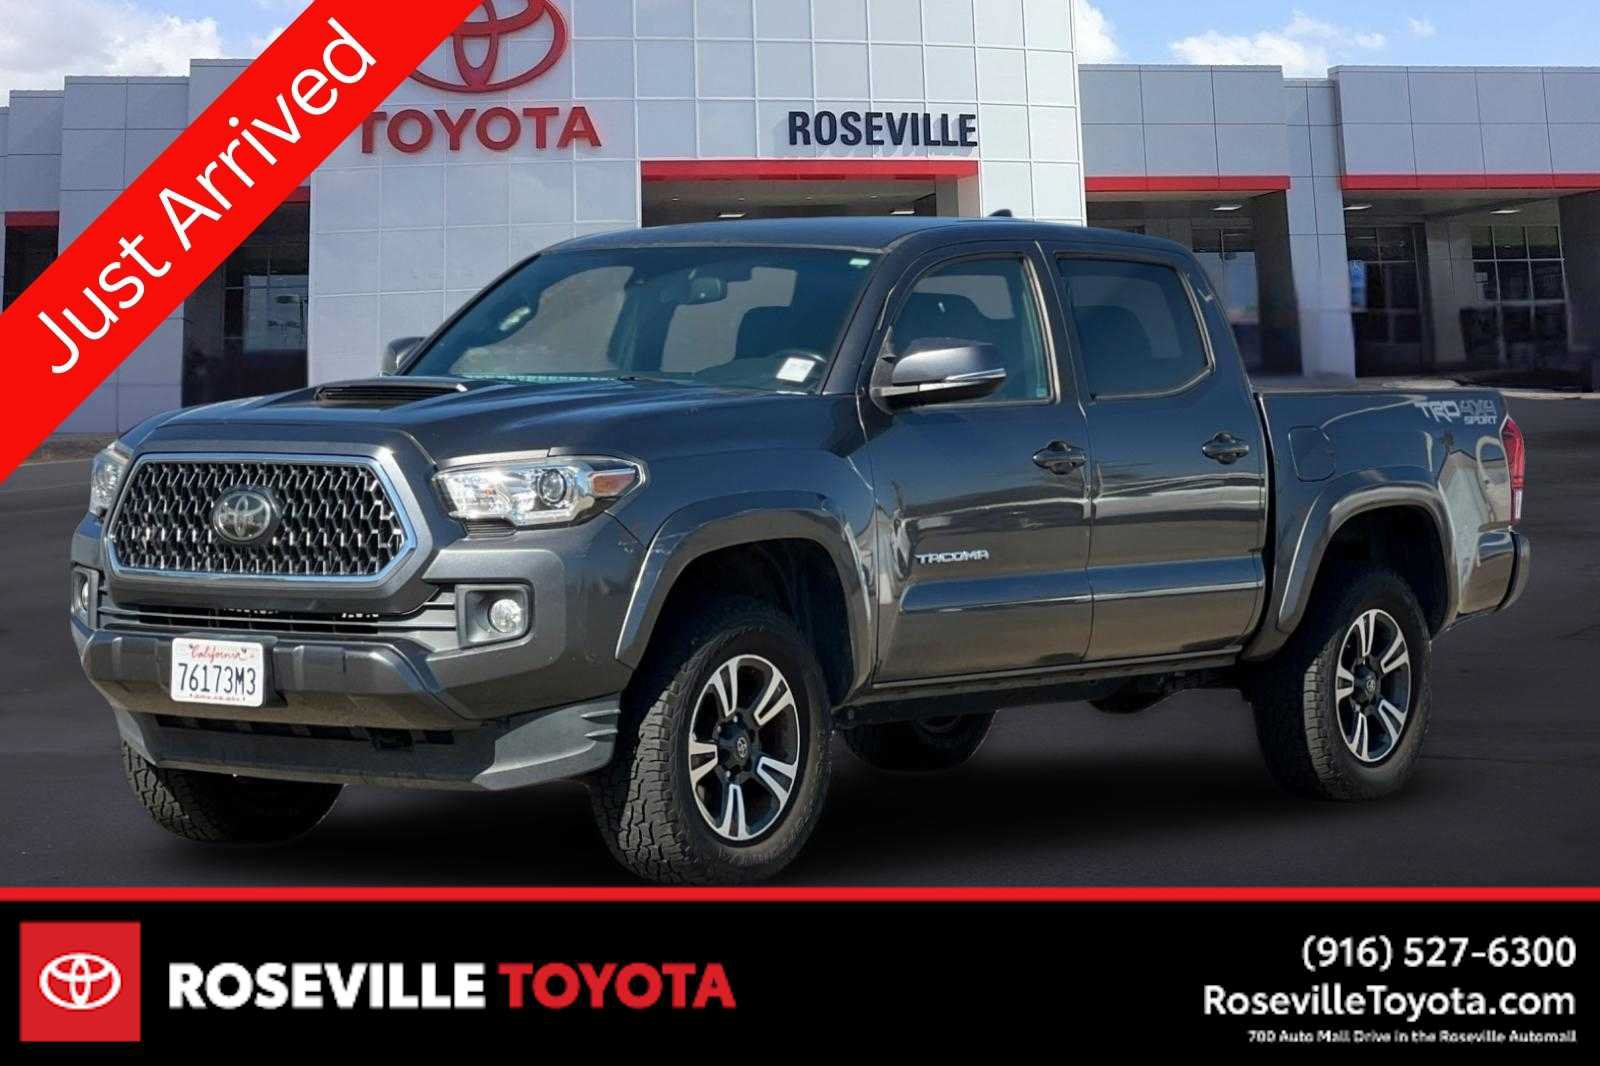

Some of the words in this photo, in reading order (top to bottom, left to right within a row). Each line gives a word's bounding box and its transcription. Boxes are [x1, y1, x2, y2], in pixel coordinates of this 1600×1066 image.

[359, 106, 602, 154] TOYOTA
[788, 111, 978, 147] ROSEVILLE
[1413, 400, 1461, 422] TRD
[1463, 415, 1498, 425] SPORT
[914, 549, 990, 565] TACOMA
[190, 644, 245, 663] California
[178, 662, 257, 696] 76173M3
